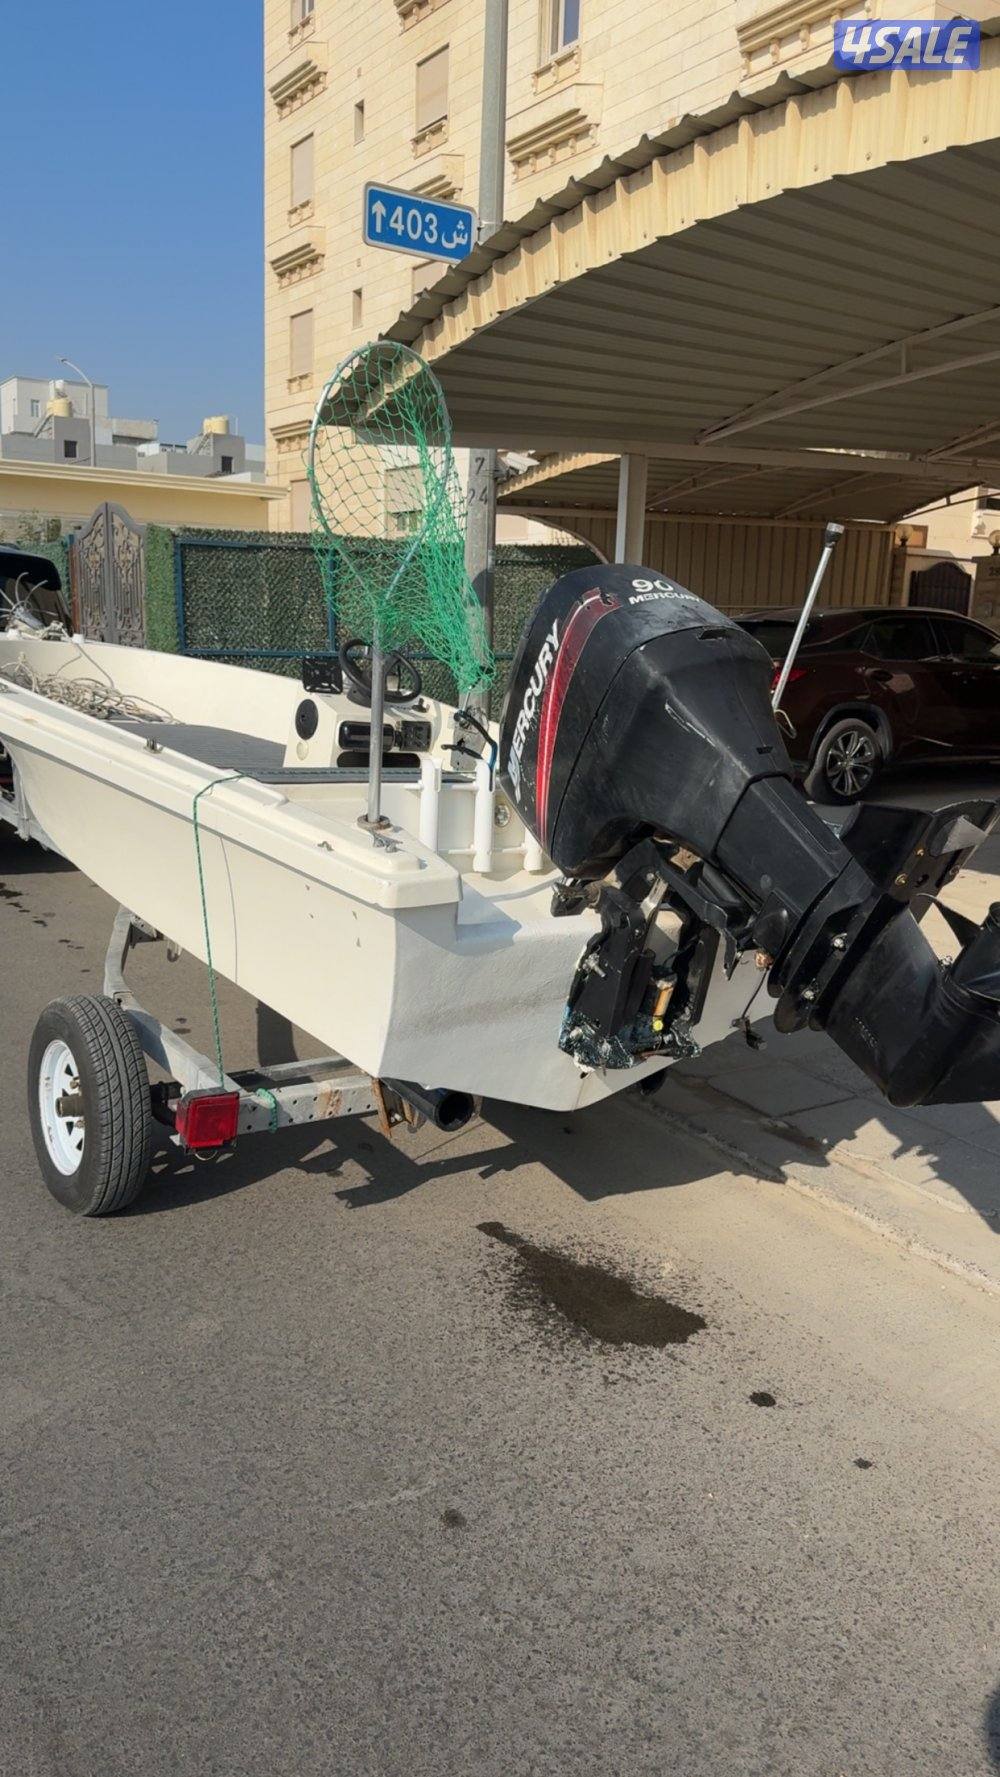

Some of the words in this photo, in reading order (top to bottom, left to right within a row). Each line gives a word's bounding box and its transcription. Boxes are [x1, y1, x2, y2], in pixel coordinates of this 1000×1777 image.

[389, 206, 438, 244] 403
[441, 219, 468, 249] ش
[629, 592, 700, 605] MERCURY
[632, 579, 674, 592] 90
[508, 618, 559, 803] MERCURY
